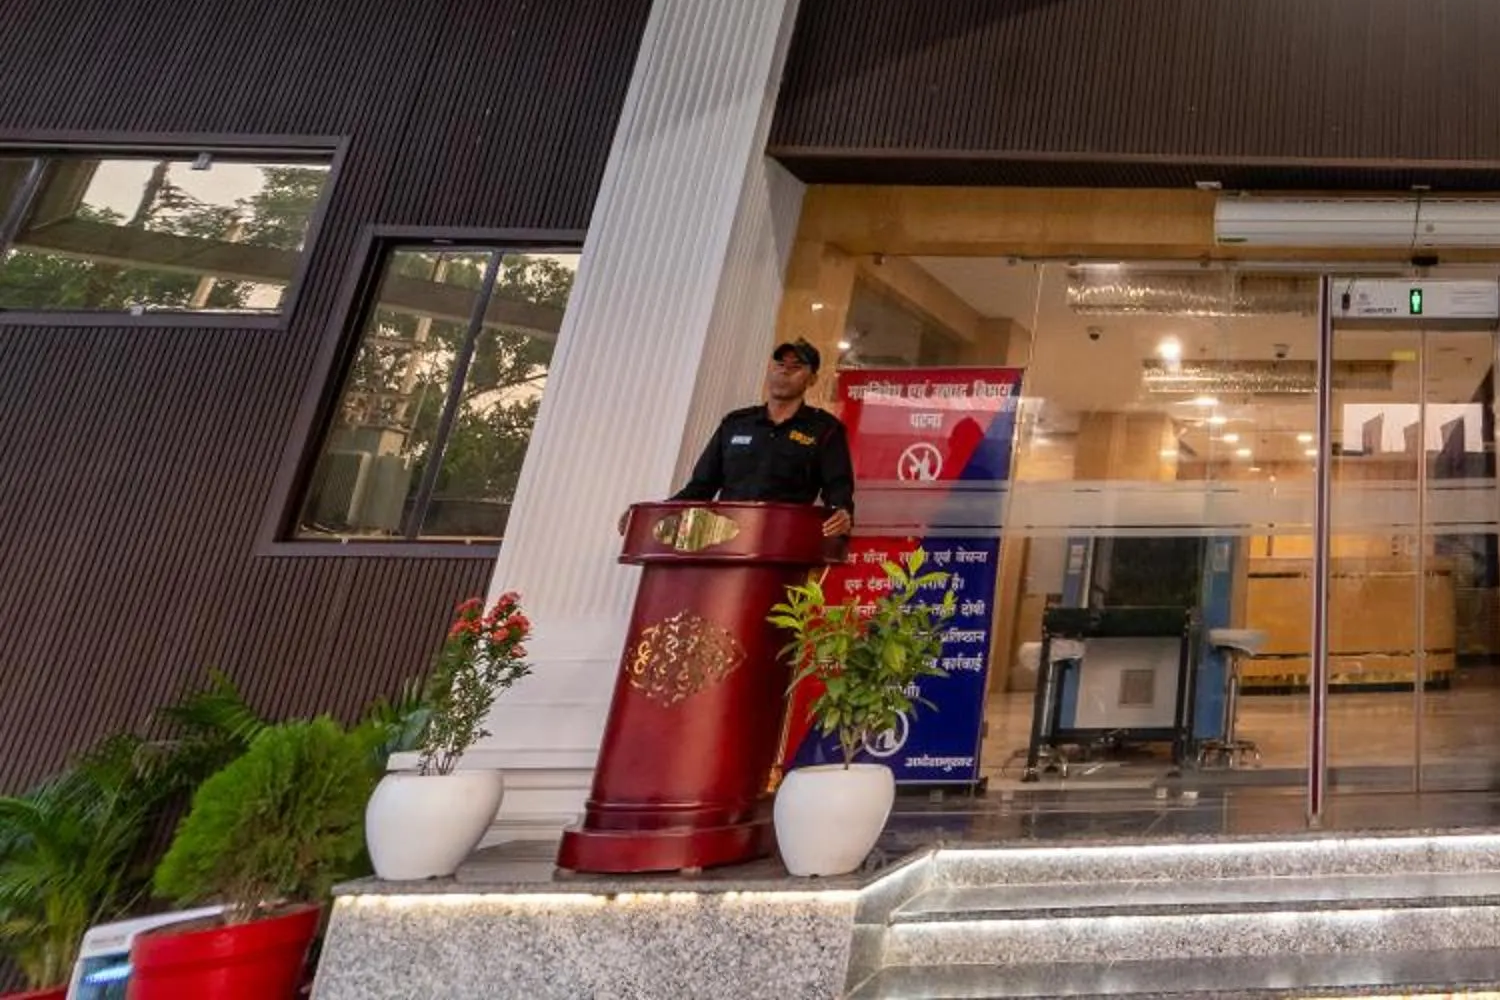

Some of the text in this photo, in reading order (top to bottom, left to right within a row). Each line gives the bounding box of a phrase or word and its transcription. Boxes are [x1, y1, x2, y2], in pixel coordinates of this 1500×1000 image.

[911, 412, 943, 428] पटना
[933, 547, 952, 567] एवं
[955, 545, 988, 563] बेचना
[843, 578, 864, 594] एक
[960, 599, 985, 617] दोषी
